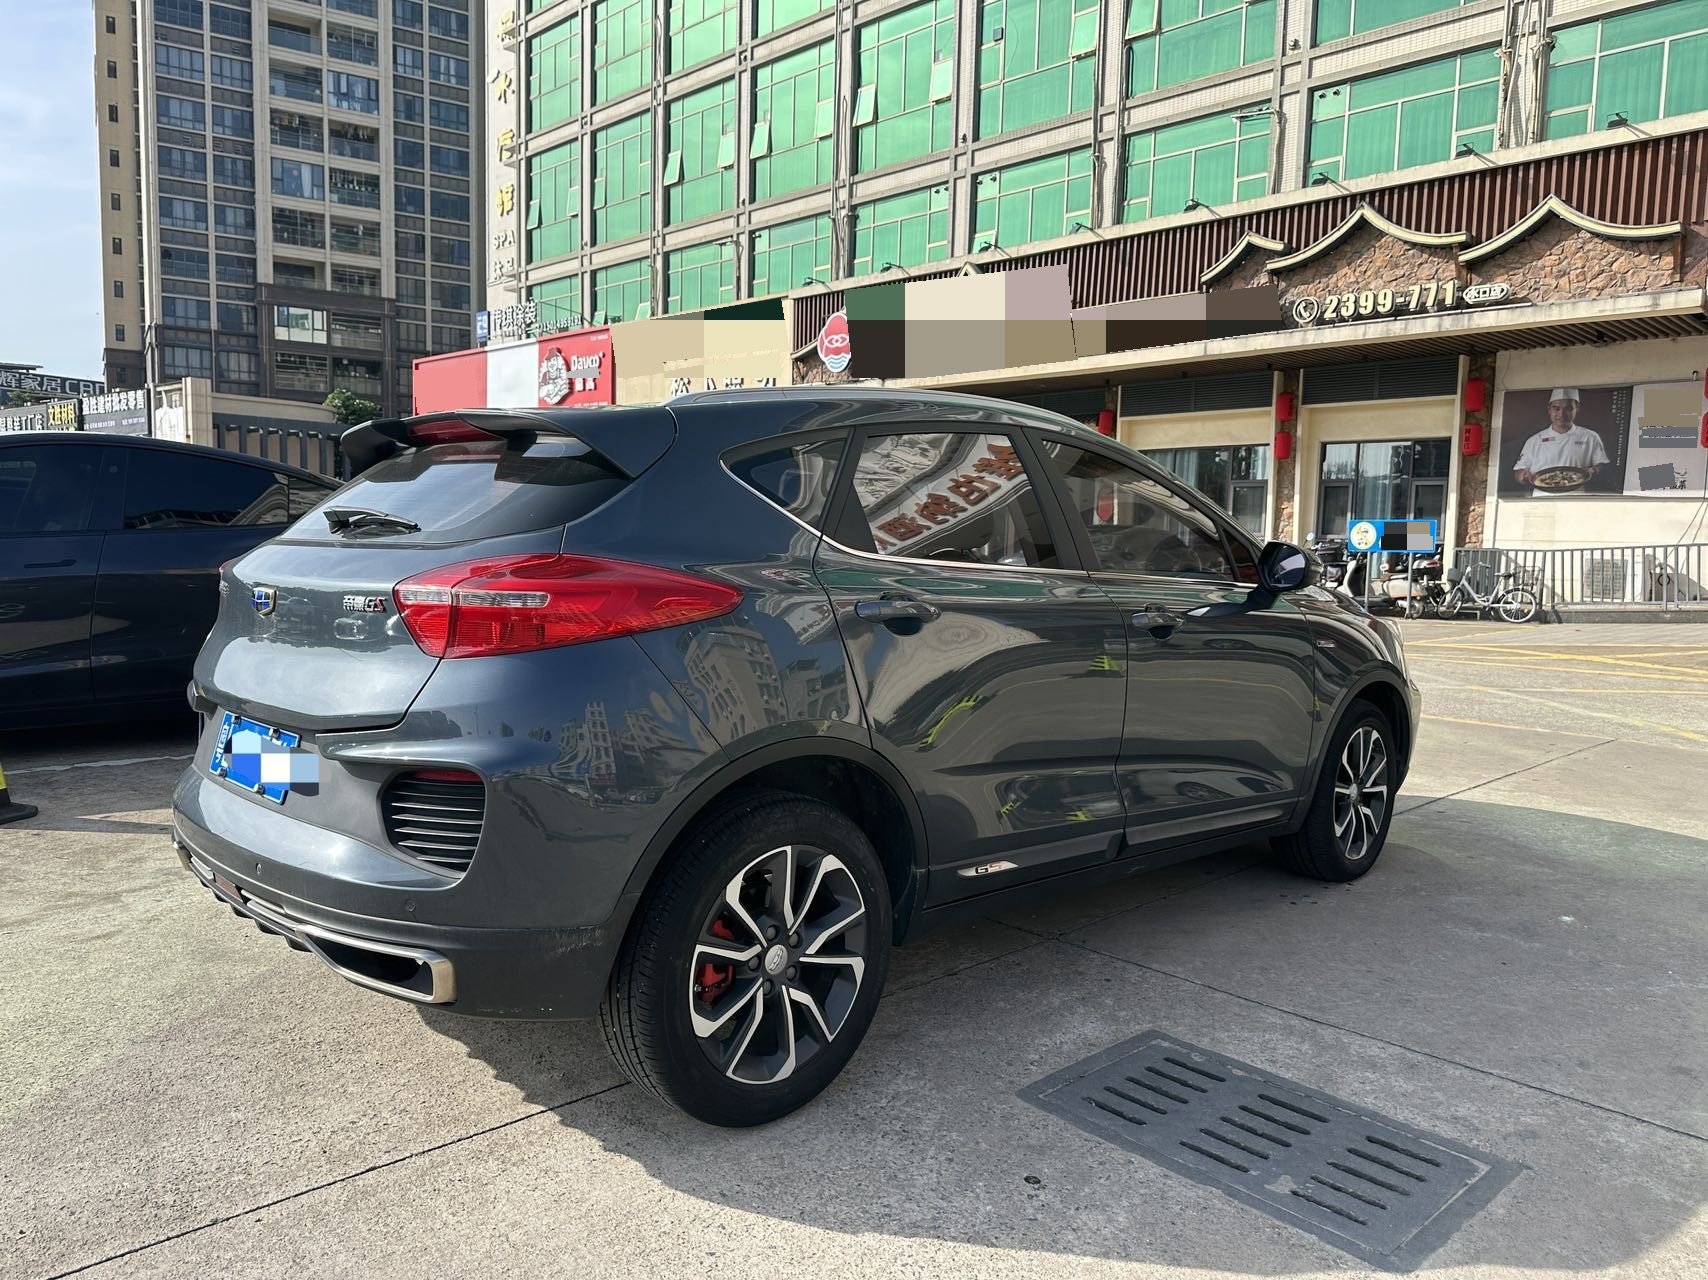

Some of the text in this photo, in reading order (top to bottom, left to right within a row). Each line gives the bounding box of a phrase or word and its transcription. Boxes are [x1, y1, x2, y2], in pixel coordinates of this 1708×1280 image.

[493, 229, 516, 250] SPA
[1323, 280, 1457, 319] 2399-771
[0, 370, 61, 393] 辉家居
